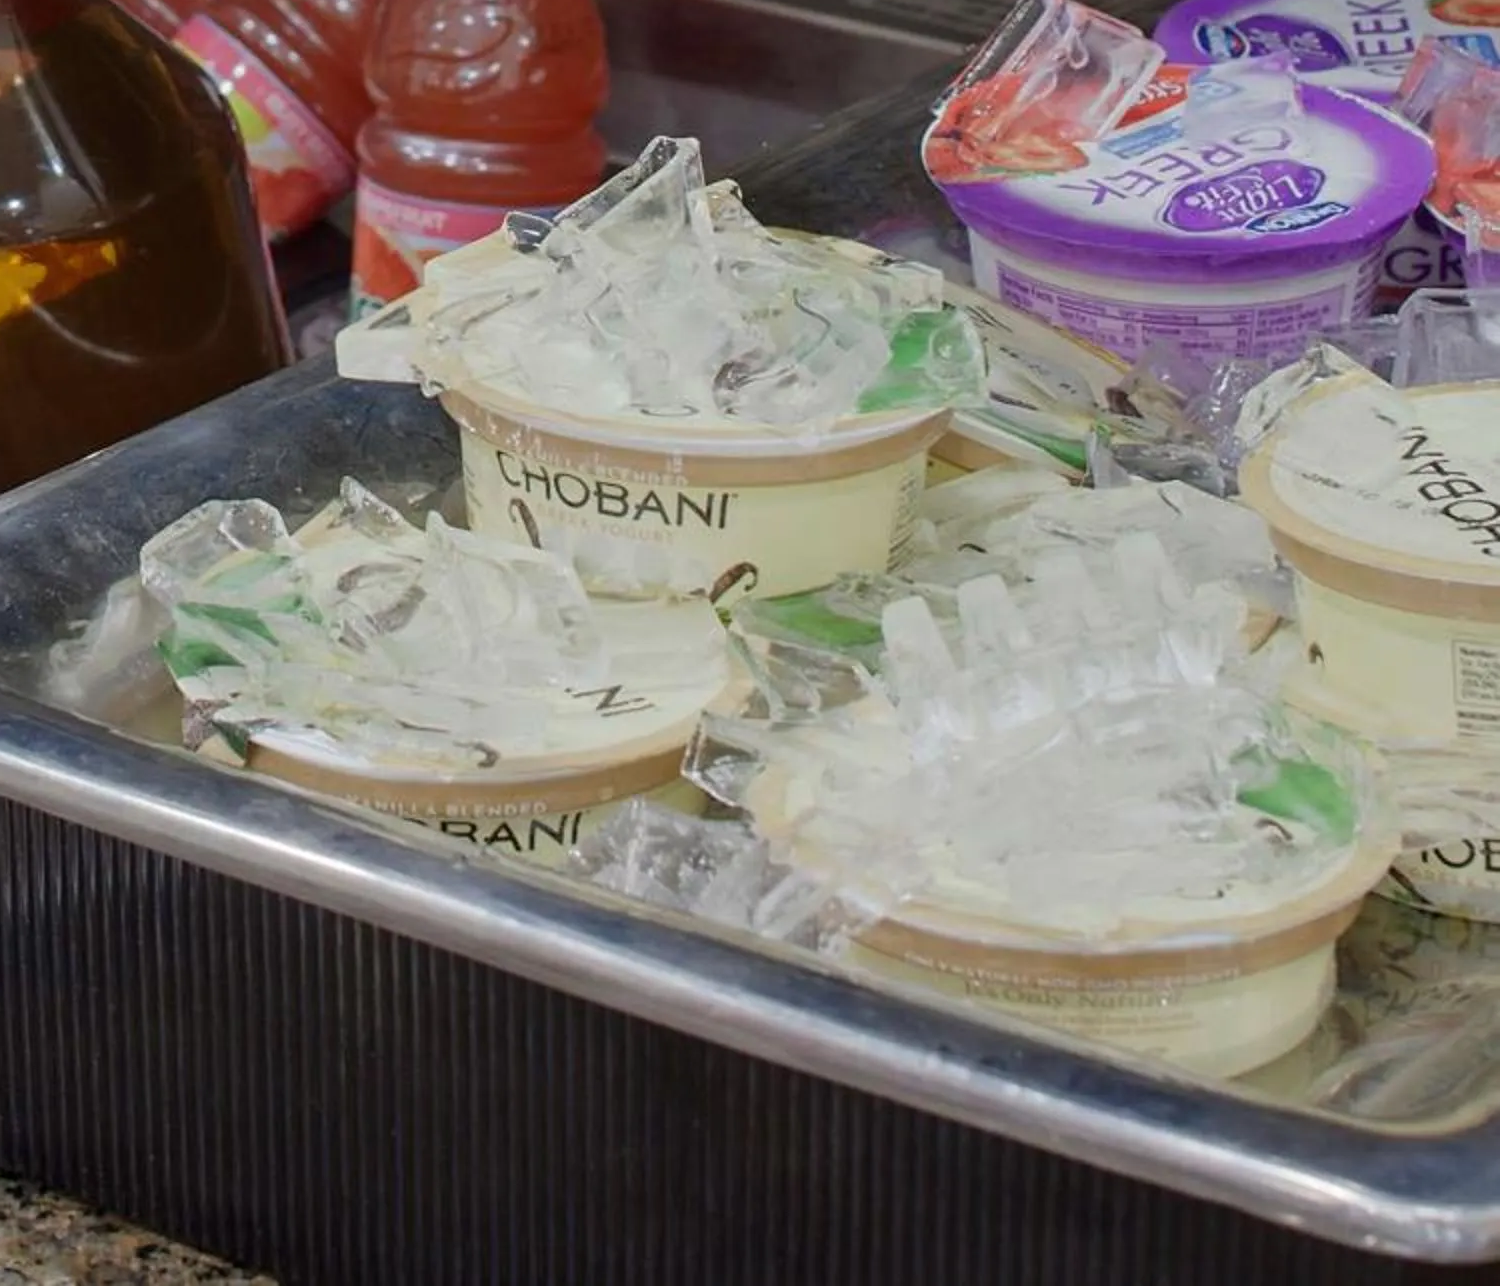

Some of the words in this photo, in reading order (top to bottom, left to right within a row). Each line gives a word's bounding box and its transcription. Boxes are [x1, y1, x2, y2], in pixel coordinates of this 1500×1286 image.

[1056, 125, 1293, 206] GREEK
[1216, 174, 1304, 223] Light
[495, 449, 733, 530] CHOBANI
[1400, 425, 1500, 558] HOBANI
